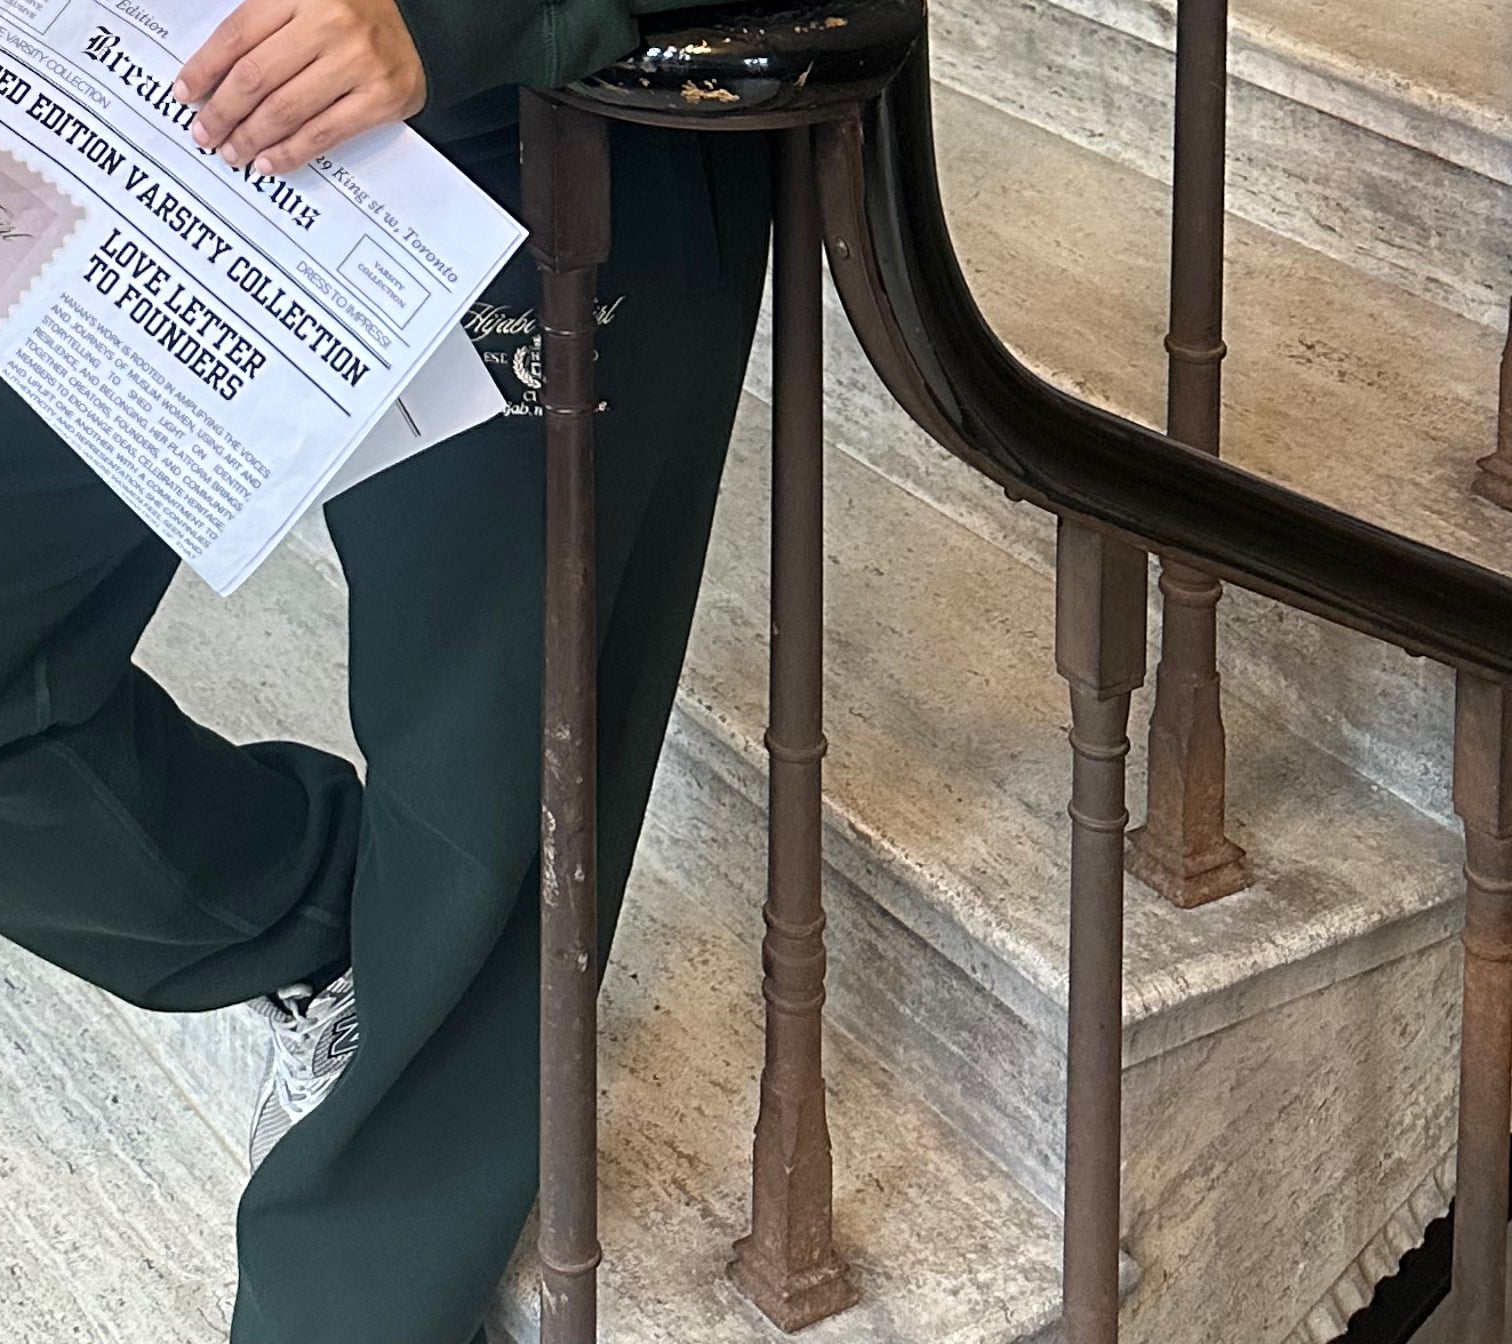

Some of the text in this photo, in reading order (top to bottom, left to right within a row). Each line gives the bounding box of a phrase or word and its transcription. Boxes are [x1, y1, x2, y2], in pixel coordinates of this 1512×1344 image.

[5, 31, 50, 64] VARSITY
[45, 58, 112, 110] COLLECTION
[24, 91, 127, 177] EDITION
[124, 164, 234, 265] VARSITY
[225, 255, 371, 388] COLLECTION
[231, 159, 322, 231] ews
[330, 163, 370, 205] King
[402, 226, 459, 284] Toronto
[82, 253, 245, 402] TO FOUNDERS
[98, 226, 267, 381] LOVE LETTER
[295, 259, 334, 296] DRESS
[330, 289, 349, 309] TO
[5, 359, 28, 379] AND
[26, 375, 57, 403] UPLIFT
[54, 400, 76, 420] ONE
[73, 417, 116, 455] ANOTHER
[115, 452, 140, 474] WITH
[137, 472, 147, 482] A
[204, 526, 220, 542] TO
[14, 347, 58, 388] MEMBERS
[55, 381, 70, 398] TO
[66, 393, 114, 437] EXCHANGE
[137, 454, 186, 498] CELEBRATE
[24, 335, 69, 379] TOGETHER
[160, 456, 183, 477] AND
[181, 474, 237, 522] COMMUNITY
[40, 313, 102, 370] STORYTELLING
[107, 369, 122, 387] TO
[126, 388, 153, 413] SHED
[157, 415, 187, 440] LIGHT
[190, 443, 208, 461] ON
[49, 303, 72, 324] AND
[69, 321, 116, 362] JOURNEYS
[113, 357, 130, 371] OF
[125, 368, 163, 403] MUSLIM
[195, 427, 226, 457] USING
[221, 453, 244, 471] ART
[239, 469, 263, 490] AND
[78, 366, 101, 387] AND
[147, 425, 169, 446] HER
[165, 440, 213, 485] PLATFORM
[210, 480, 245, 513] BRINGS
[95, 321, 124, 349] WORK
[120, 343, 133, 357] IS
[128, 351, 167, 386] ROOTED
[163, 380, 177, 396] IN
[172, 390, 225, 437] AMPLIFYING
[223, 431, 243, 452] THE
[239, 446, 272, 480] VOICES
